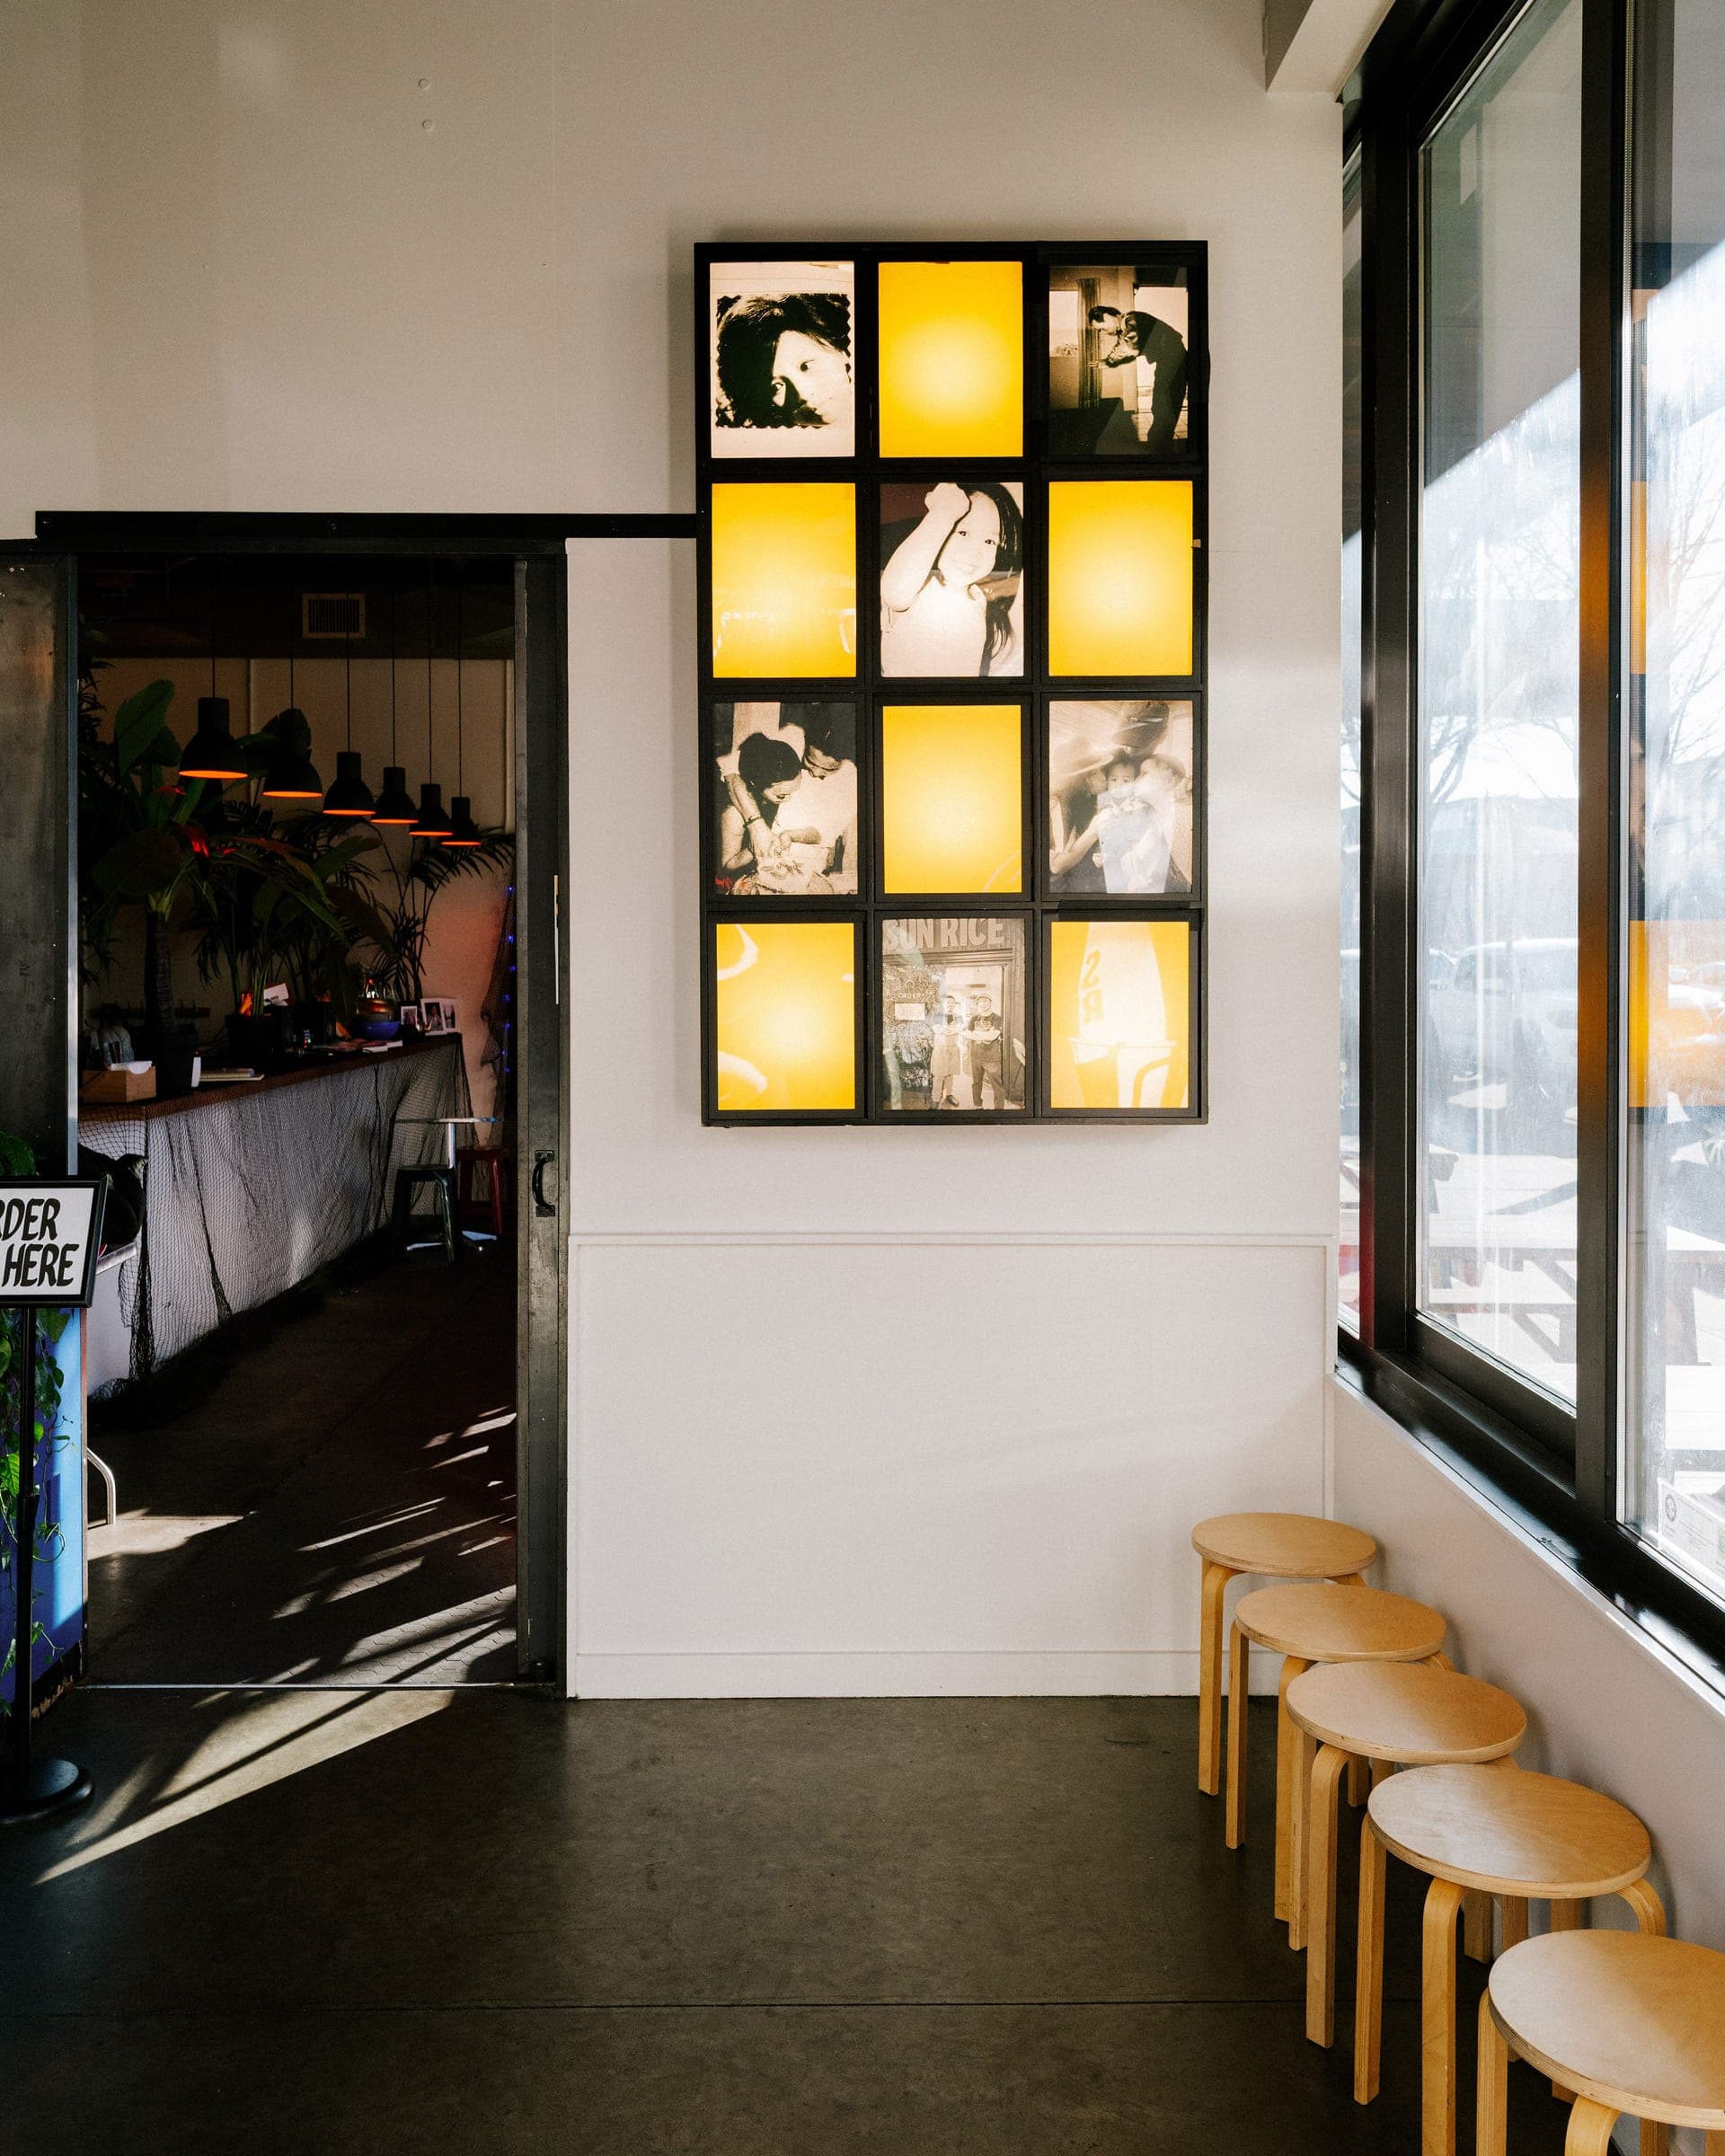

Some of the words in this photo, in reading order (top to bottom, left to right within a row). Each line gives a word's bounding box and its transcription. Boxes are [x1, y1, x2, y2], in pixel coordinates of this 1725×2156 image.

[882, 918, 933, 950] SUN
[940, 918, 1004, 948] RICE
[0, 1197, 61, 1241] DER
[2, 1242, 80, 1287] HERE
